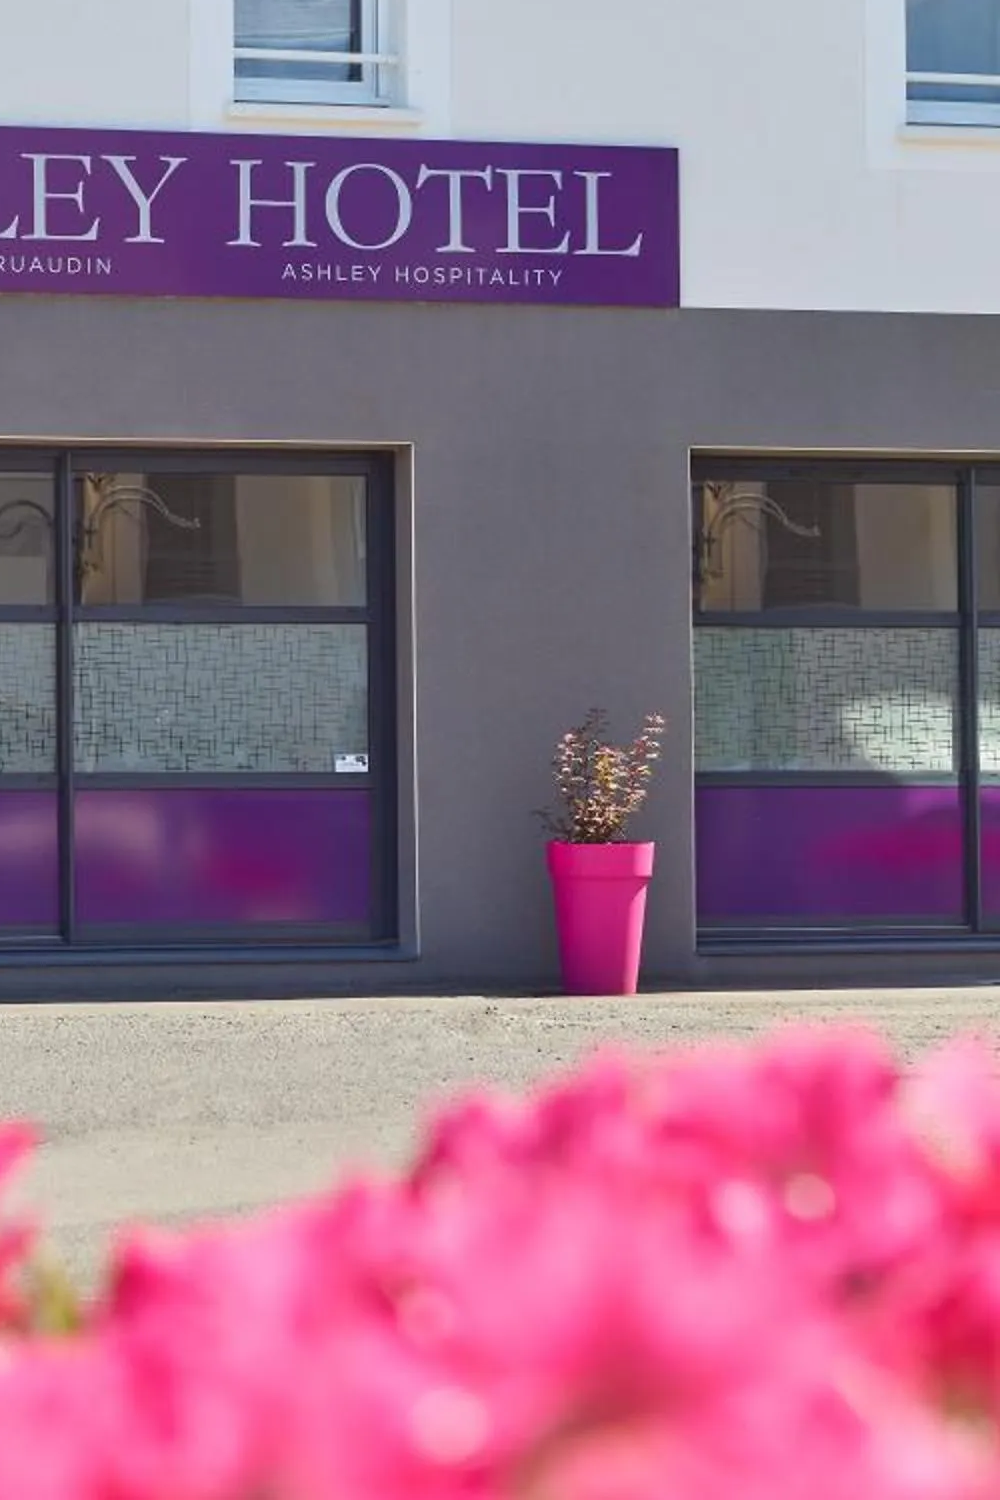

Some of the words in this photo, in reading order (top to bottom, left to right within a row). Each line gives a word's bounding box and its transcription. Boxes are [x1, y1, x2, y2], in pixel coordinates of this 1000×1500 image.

[226, 159, 644, 257] HOTEL
[281, 263, 382, 283] ASHLEY
[395, 265, 563, 286] HOSPITALITY
